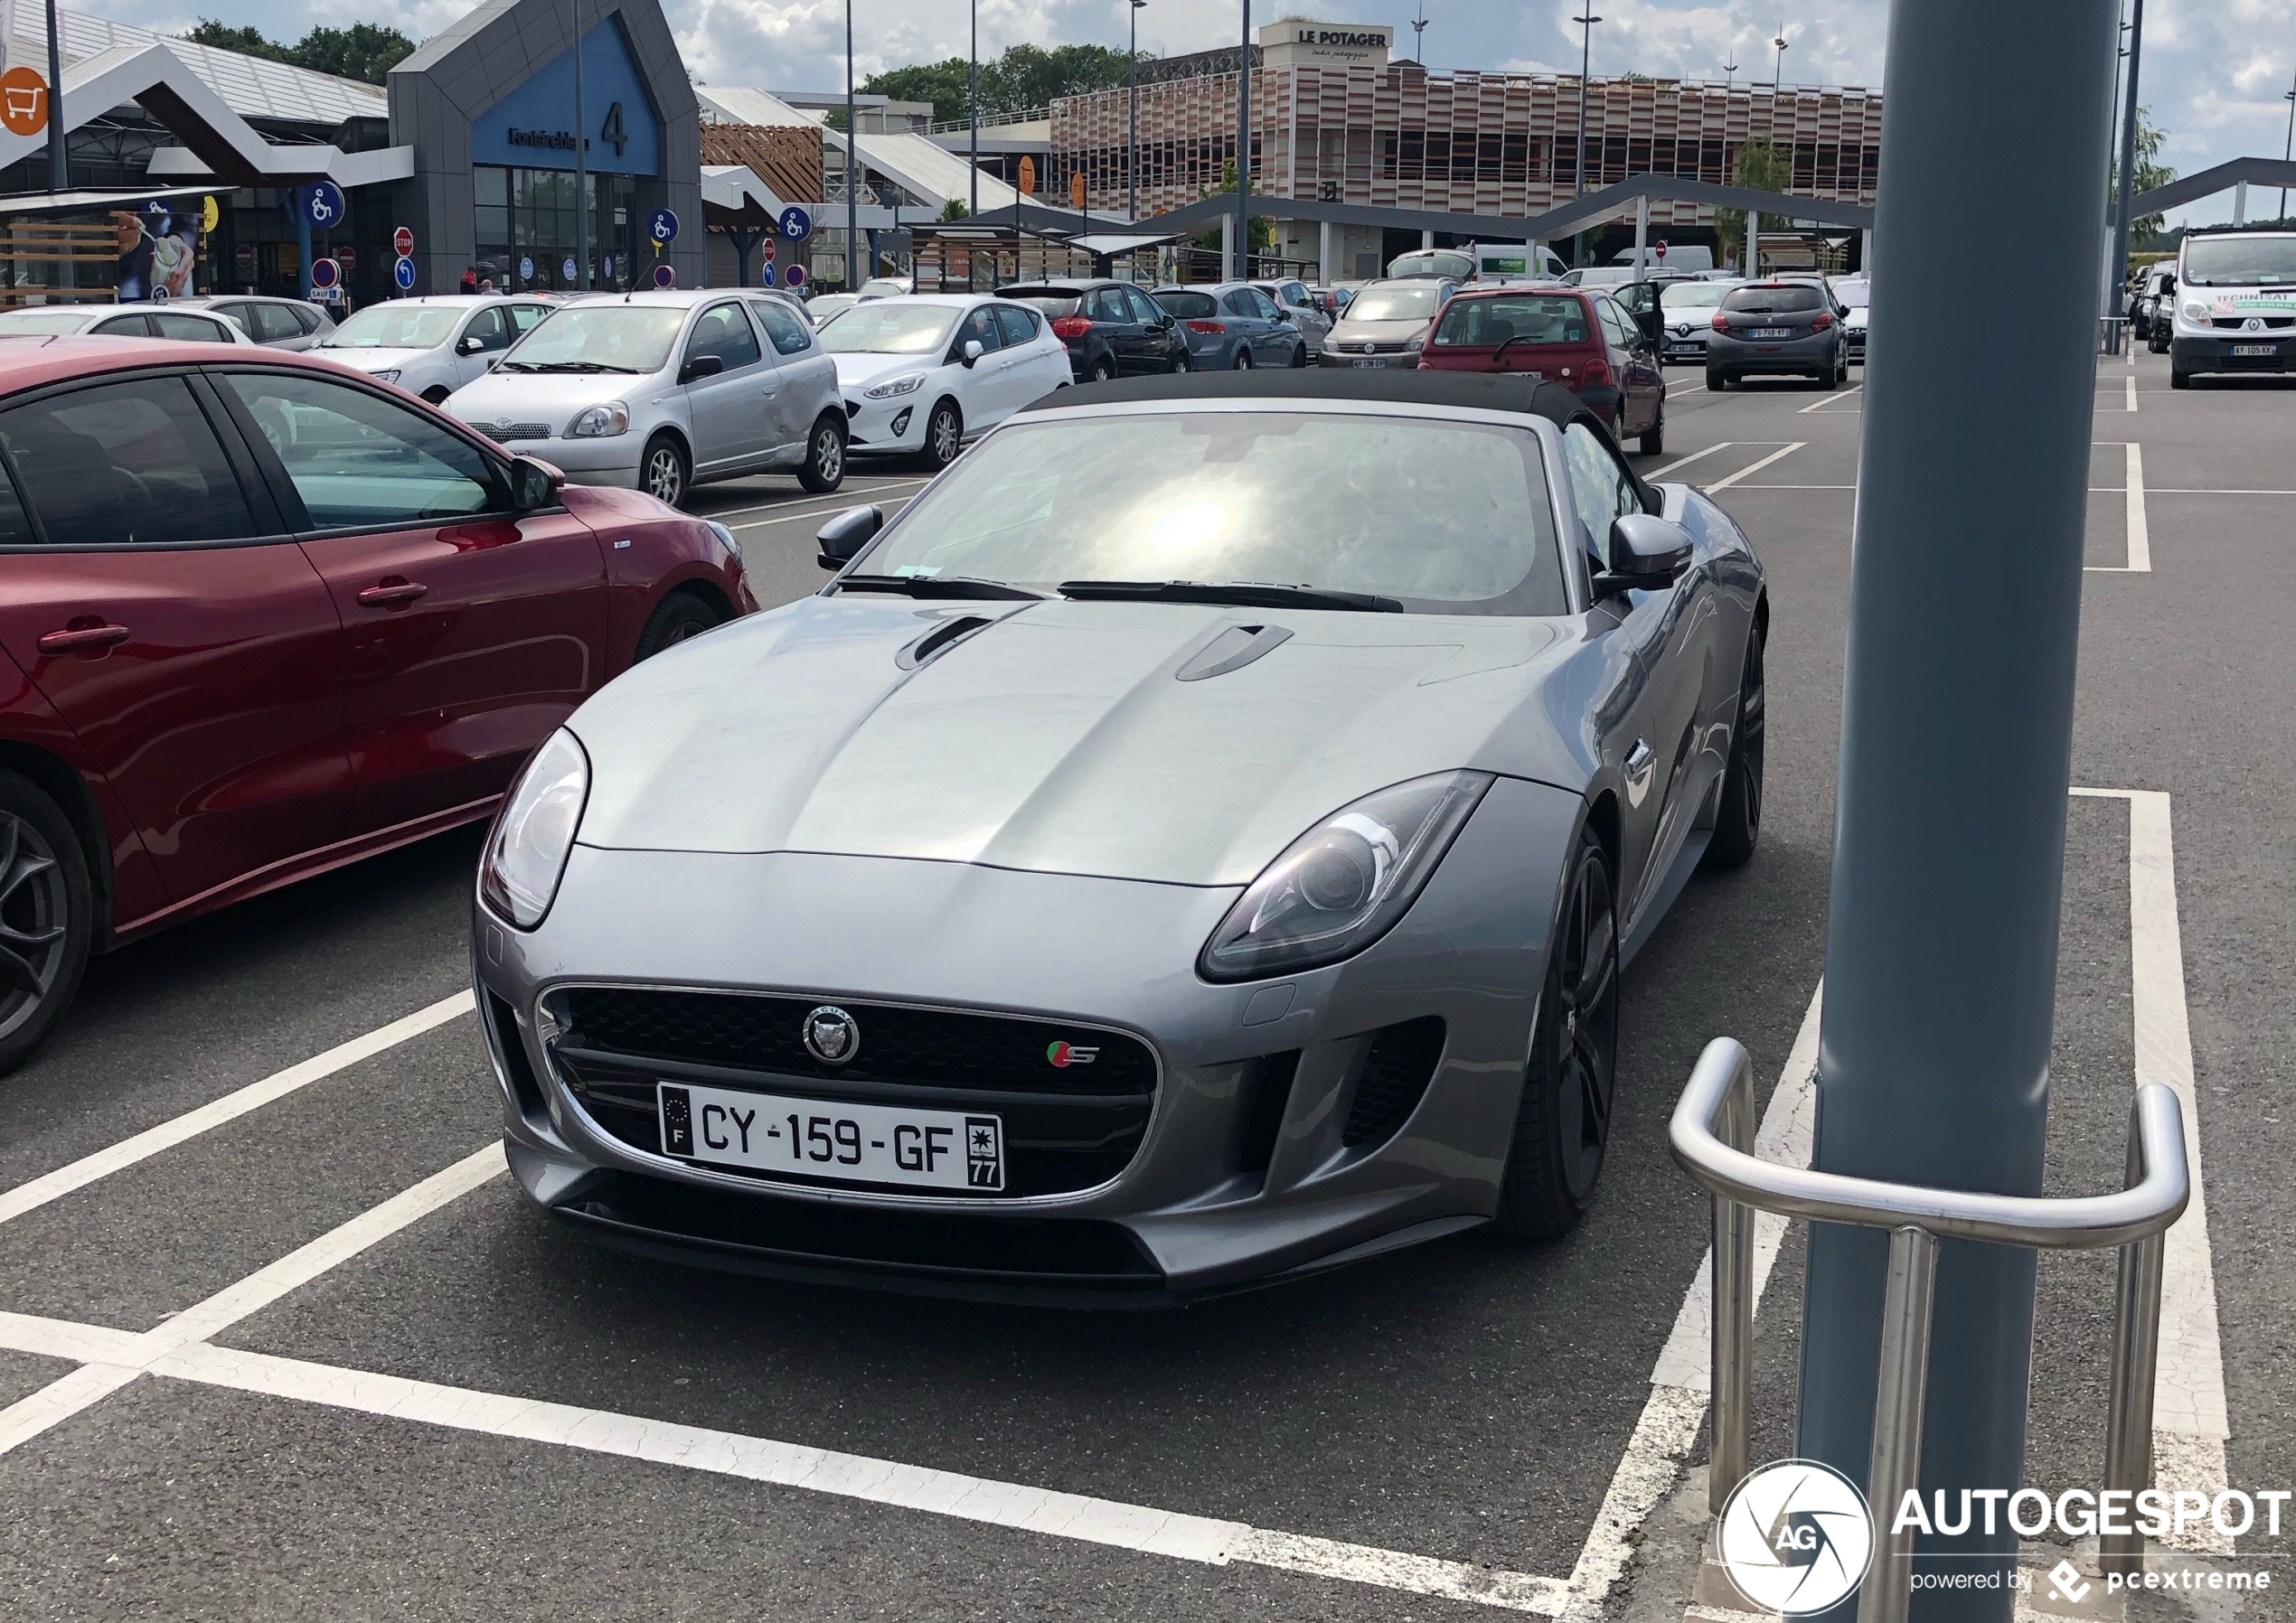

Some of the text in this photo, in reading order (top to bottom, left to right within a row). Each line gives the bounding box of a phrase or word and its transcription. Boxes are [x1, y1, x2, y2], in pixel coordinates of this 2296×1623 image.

[1299, 30, 1387, 47] LE POTAGER
[601, 101, 628, 156] 4
[507, 127, 590, 152] Fontainebleu
[397, 238, 411, 248] STOP
[312, 290, 328, 298] SAUF
[2216, 294, 2290, 302] TECHNISAT
[808, 1006, 853, 1025] JAGUAR
[673, 1129, 684, 1143] F
[970, 1159, 997, 1183] 77
